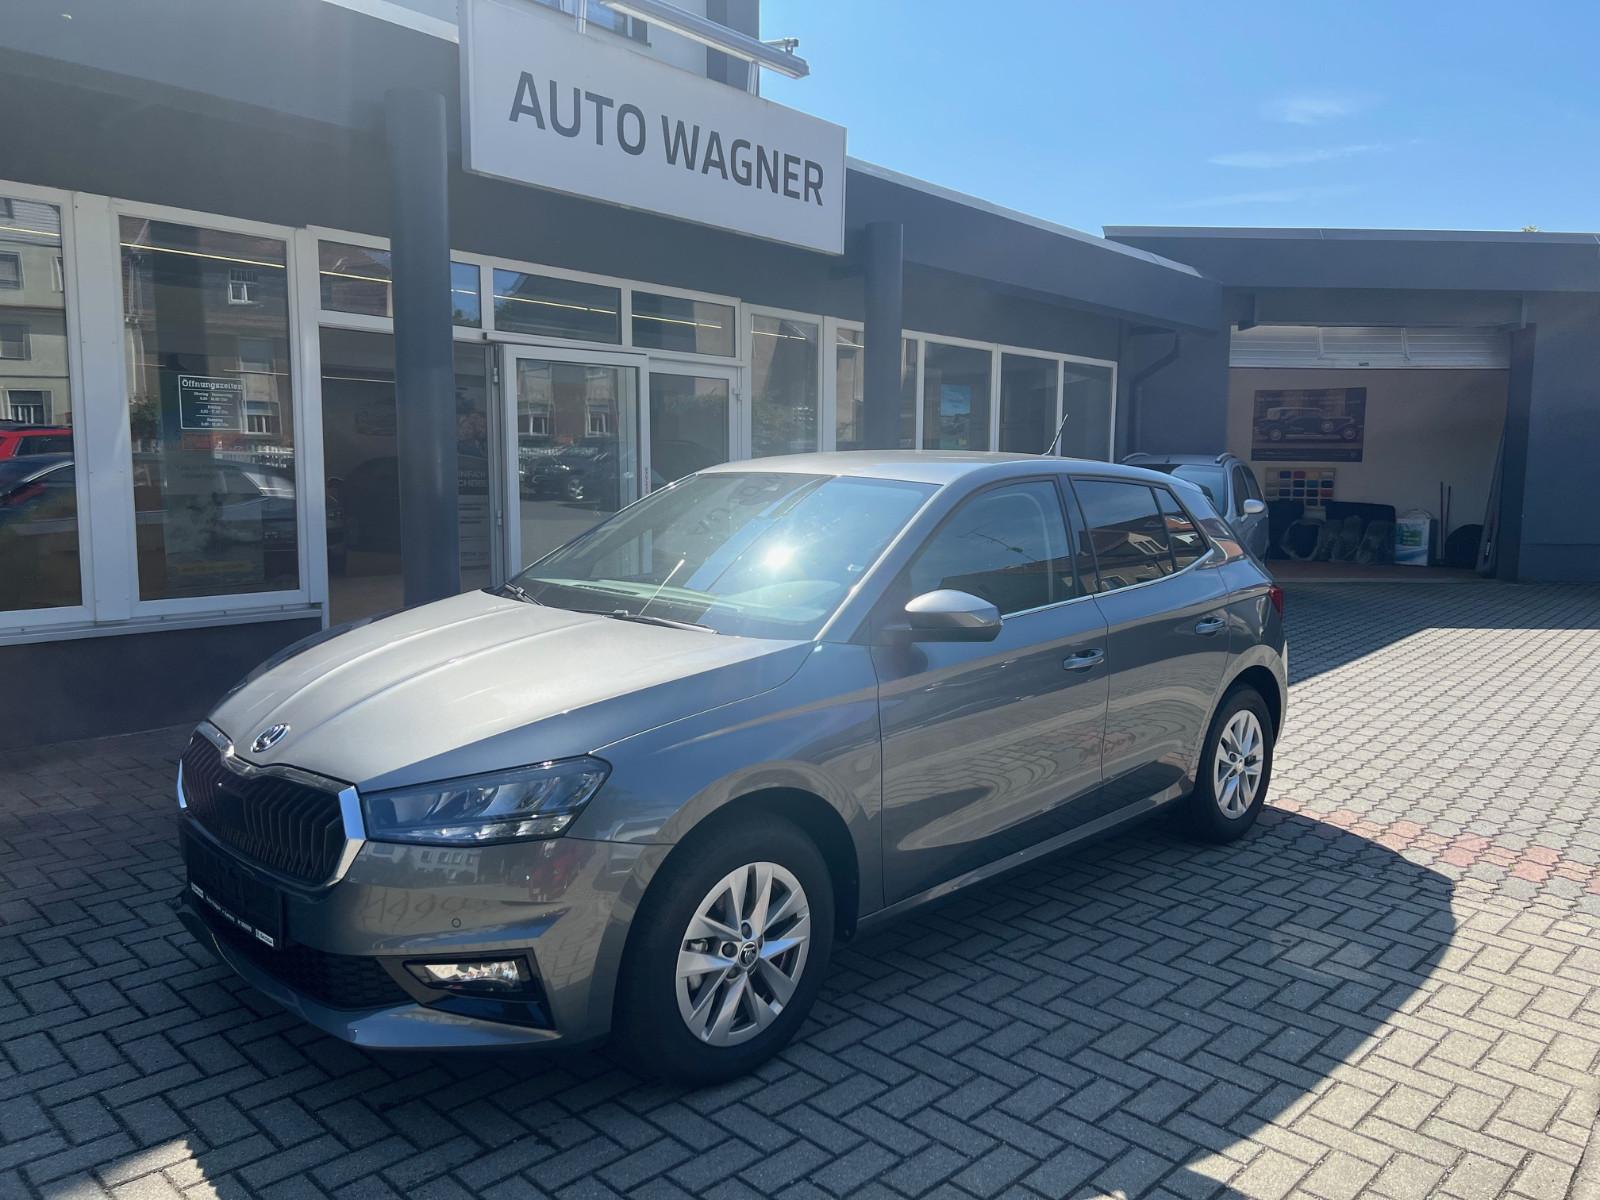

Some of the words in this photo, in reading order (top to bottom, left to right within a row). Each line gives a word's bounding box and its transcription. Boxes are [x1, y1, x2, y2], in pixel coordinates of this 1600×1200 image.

[509, 71, 646, 156] AUTO
[661, 114, 824, 206] WAGNER
[181, 379, 243, 390] Öffnungszeiten
